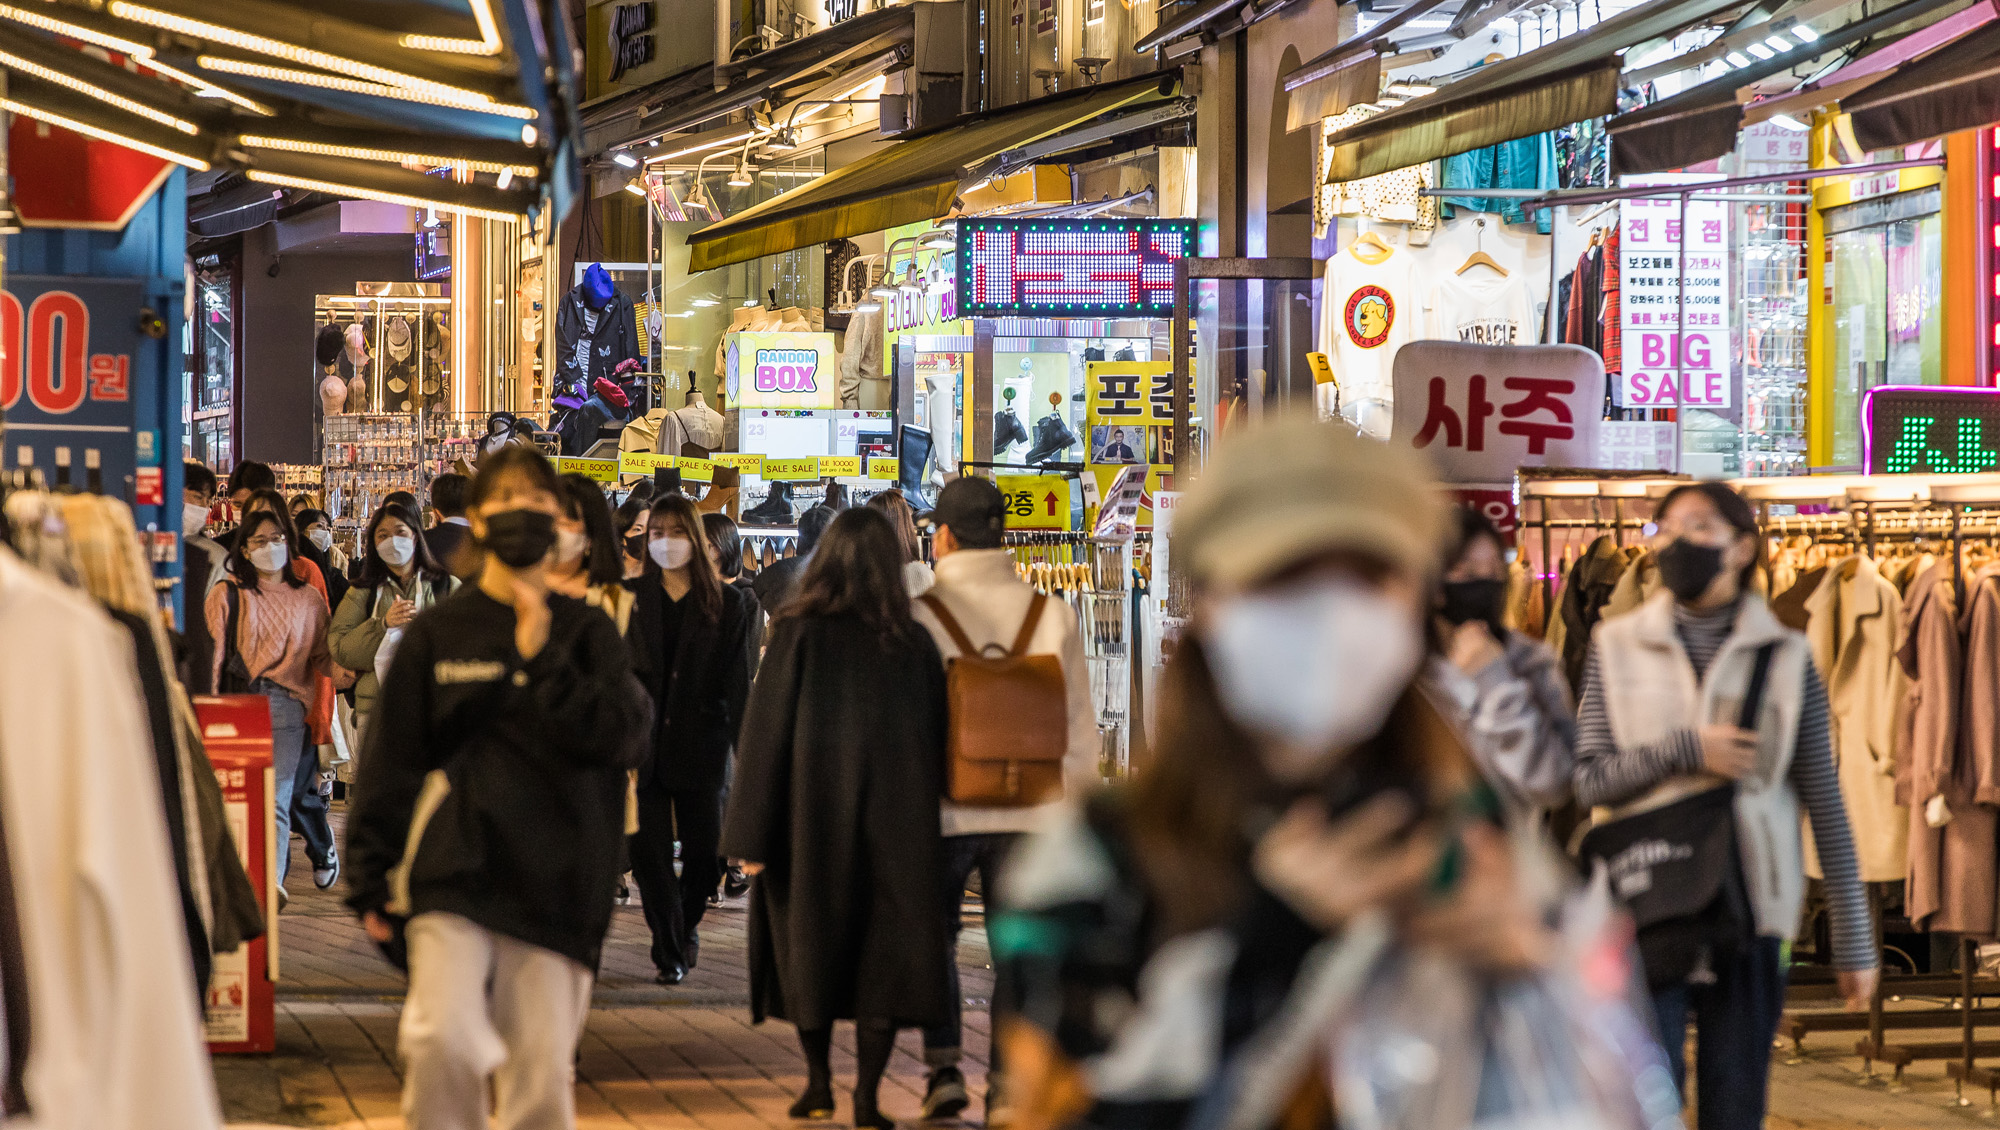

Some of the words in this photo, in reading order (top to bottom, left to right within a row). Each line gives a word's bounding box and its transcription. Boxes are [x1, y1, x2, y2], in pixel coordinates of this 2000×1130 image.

[941, 277, 957, 322] BO
[1458, 324, 1518, 345] MIRACLE
[1642, 333, 1711, 368] BIG
[759, 352, 815, 364] RANDOM
[758, 365, 815, 390] BOX
[1630, 372, 1723, 403] SALE
[1413, 375, 1575, 456] 사주
[748, 424, 765, 436] 23
[839, 425, 856, 437] 24
[564, 462, 585, 471] SALE
[589, 464, 613, 472] 5000
[625, 458, 646, 467] SALE
[650, 460, 671, 468] SALE
[679, 460, 699, 470] SALE
[703, 463, 714, 471] 50
[766, 465, 788, 473] SALE
[792, 464, 814, 473] SALE
[873, 465, 896, 473] SALE
[1002, 490, 1034, 517] 2층
